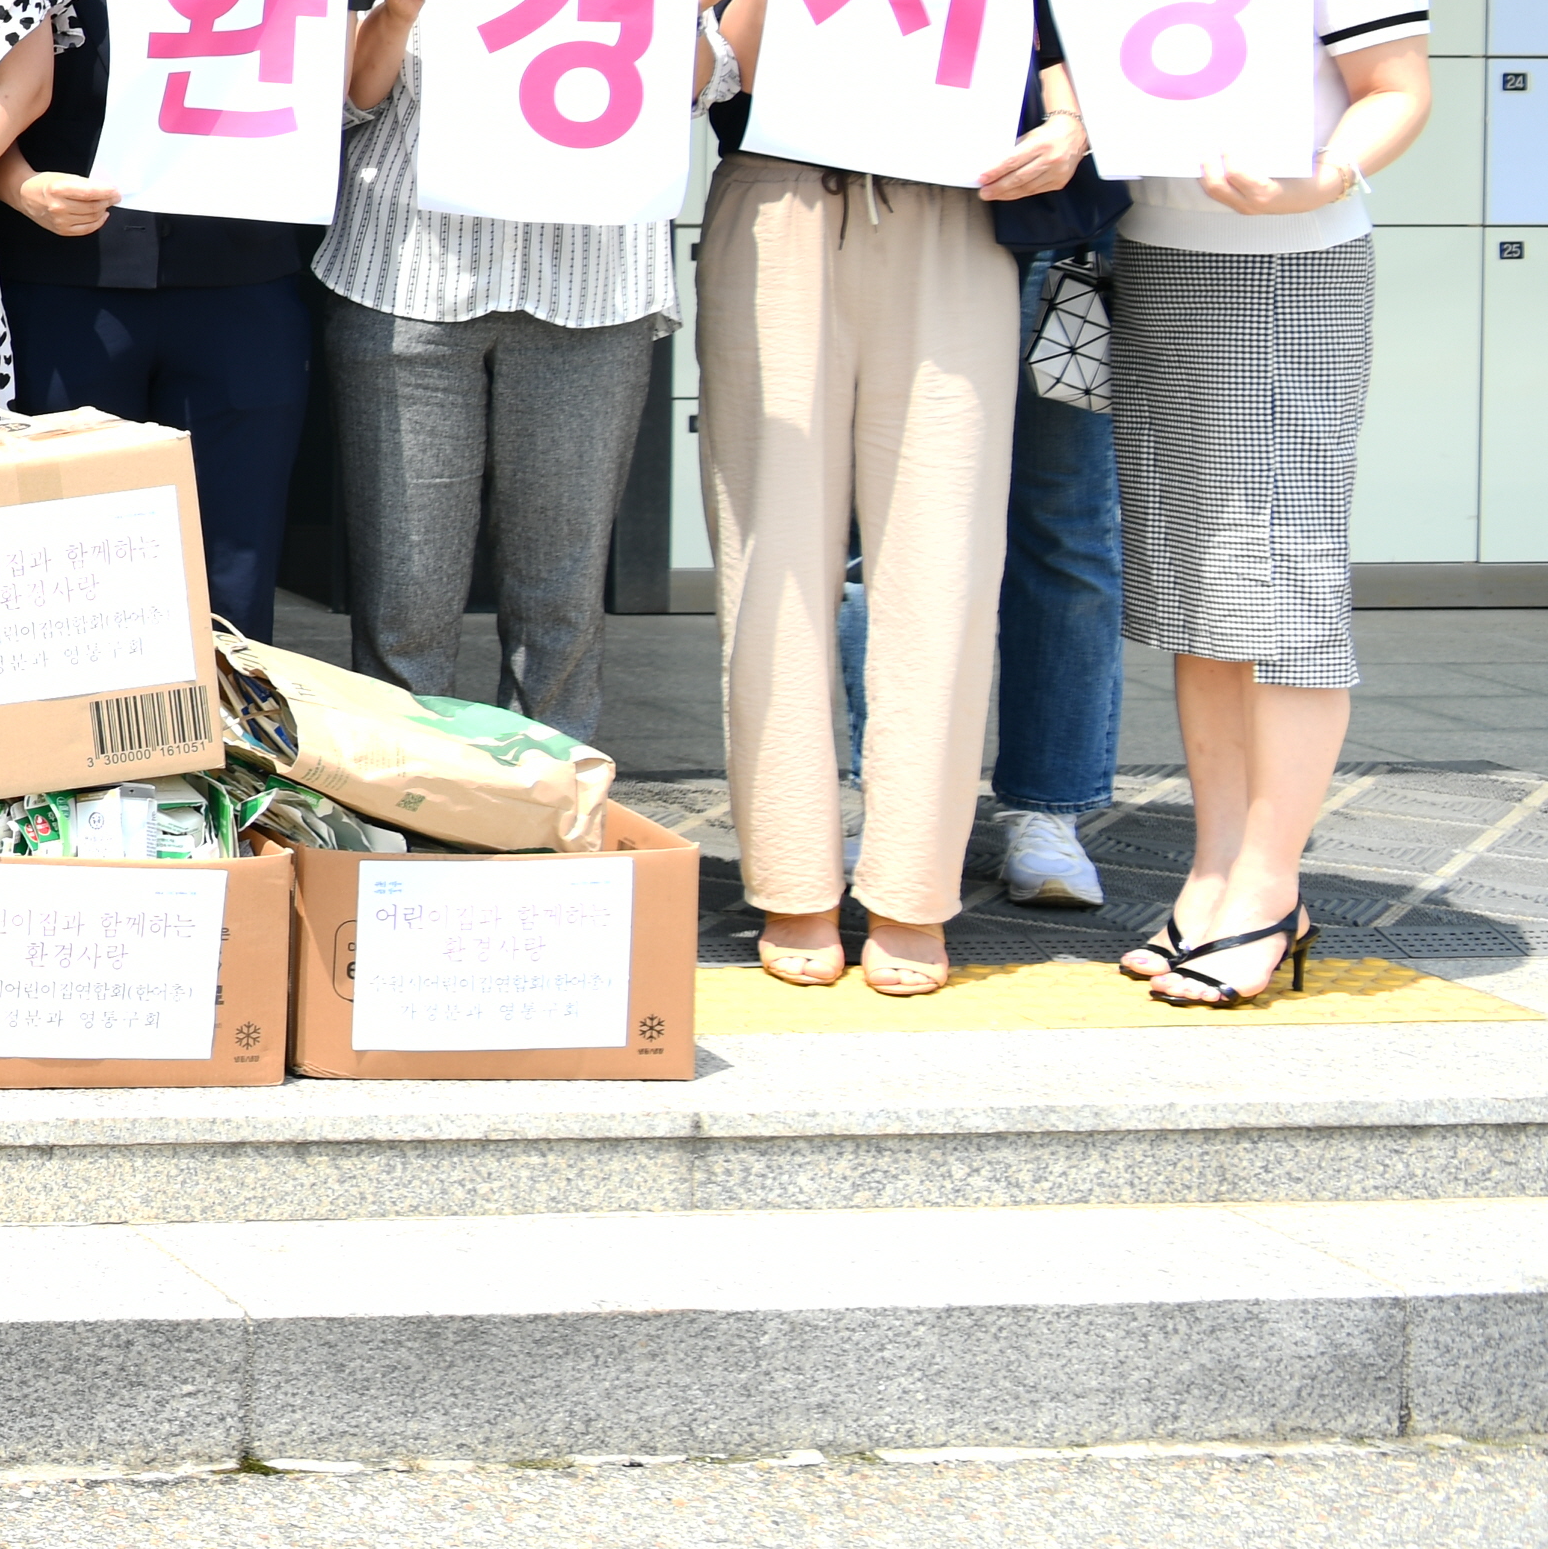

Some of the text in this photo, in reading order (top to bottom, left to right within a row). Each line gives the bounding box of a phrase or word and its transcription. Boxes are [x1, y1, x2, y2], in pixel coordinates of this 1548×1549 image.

[1506, 75, 1525, 90] 24
[1502, 243, 1521, 258] 25
[86, 740, 207, 768] 3 300000 161051
